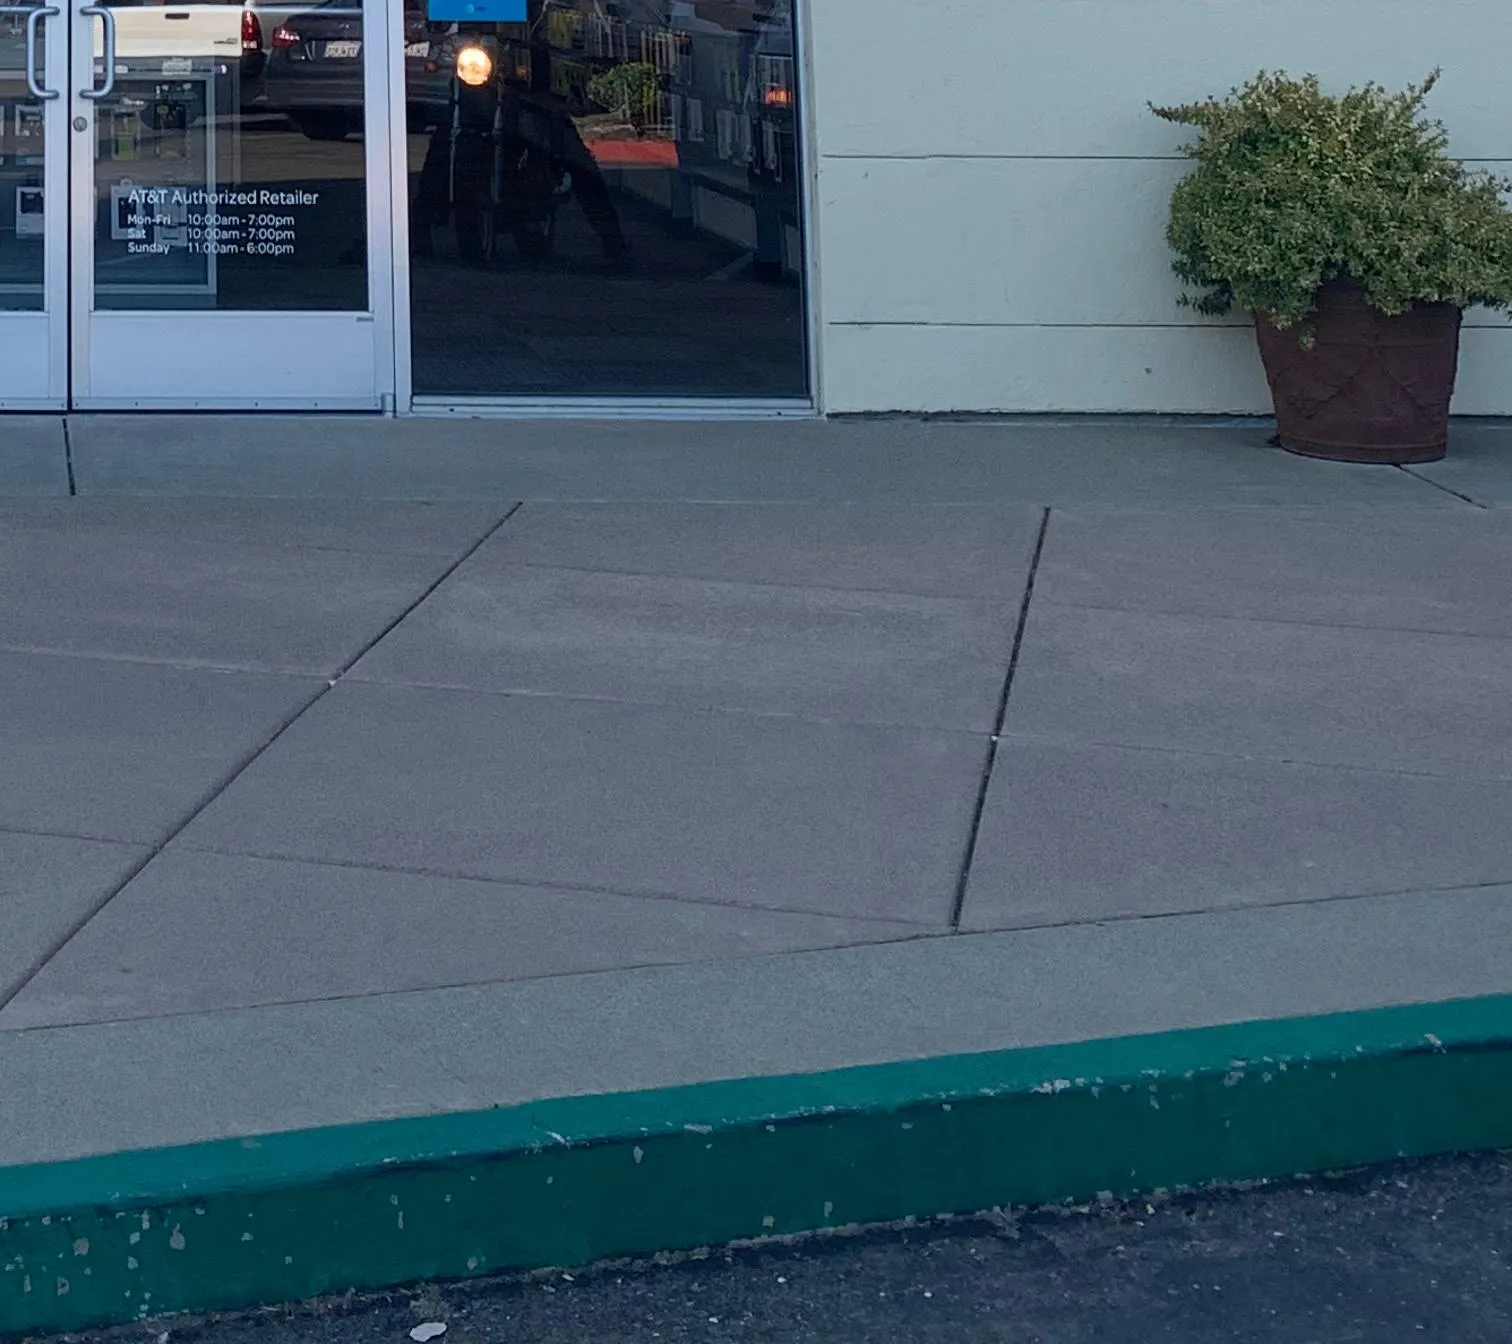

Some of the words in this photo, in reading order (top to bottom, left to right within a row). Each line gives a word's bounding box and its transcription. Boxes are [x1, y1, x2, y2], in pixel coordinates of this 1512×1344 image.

[128, 189, 168, 204] AT&T
[171, 189, 257, 204] Authorized
[260, 189, 319, 205] Retailer
[128, 214, 171, 225] Mon-Fri
[188, 214, 239, 225] 10:00am
[248, 214, 295, 228] 7:00pm
[128, 228, 146, 239] Sat
[188, 228, 240, 239] 10:00am
[248, 228, 295, 242] 7:00pm
[128, 242, 170, 255] Sunday
[246, 242, 294, 256] 6:00pm
